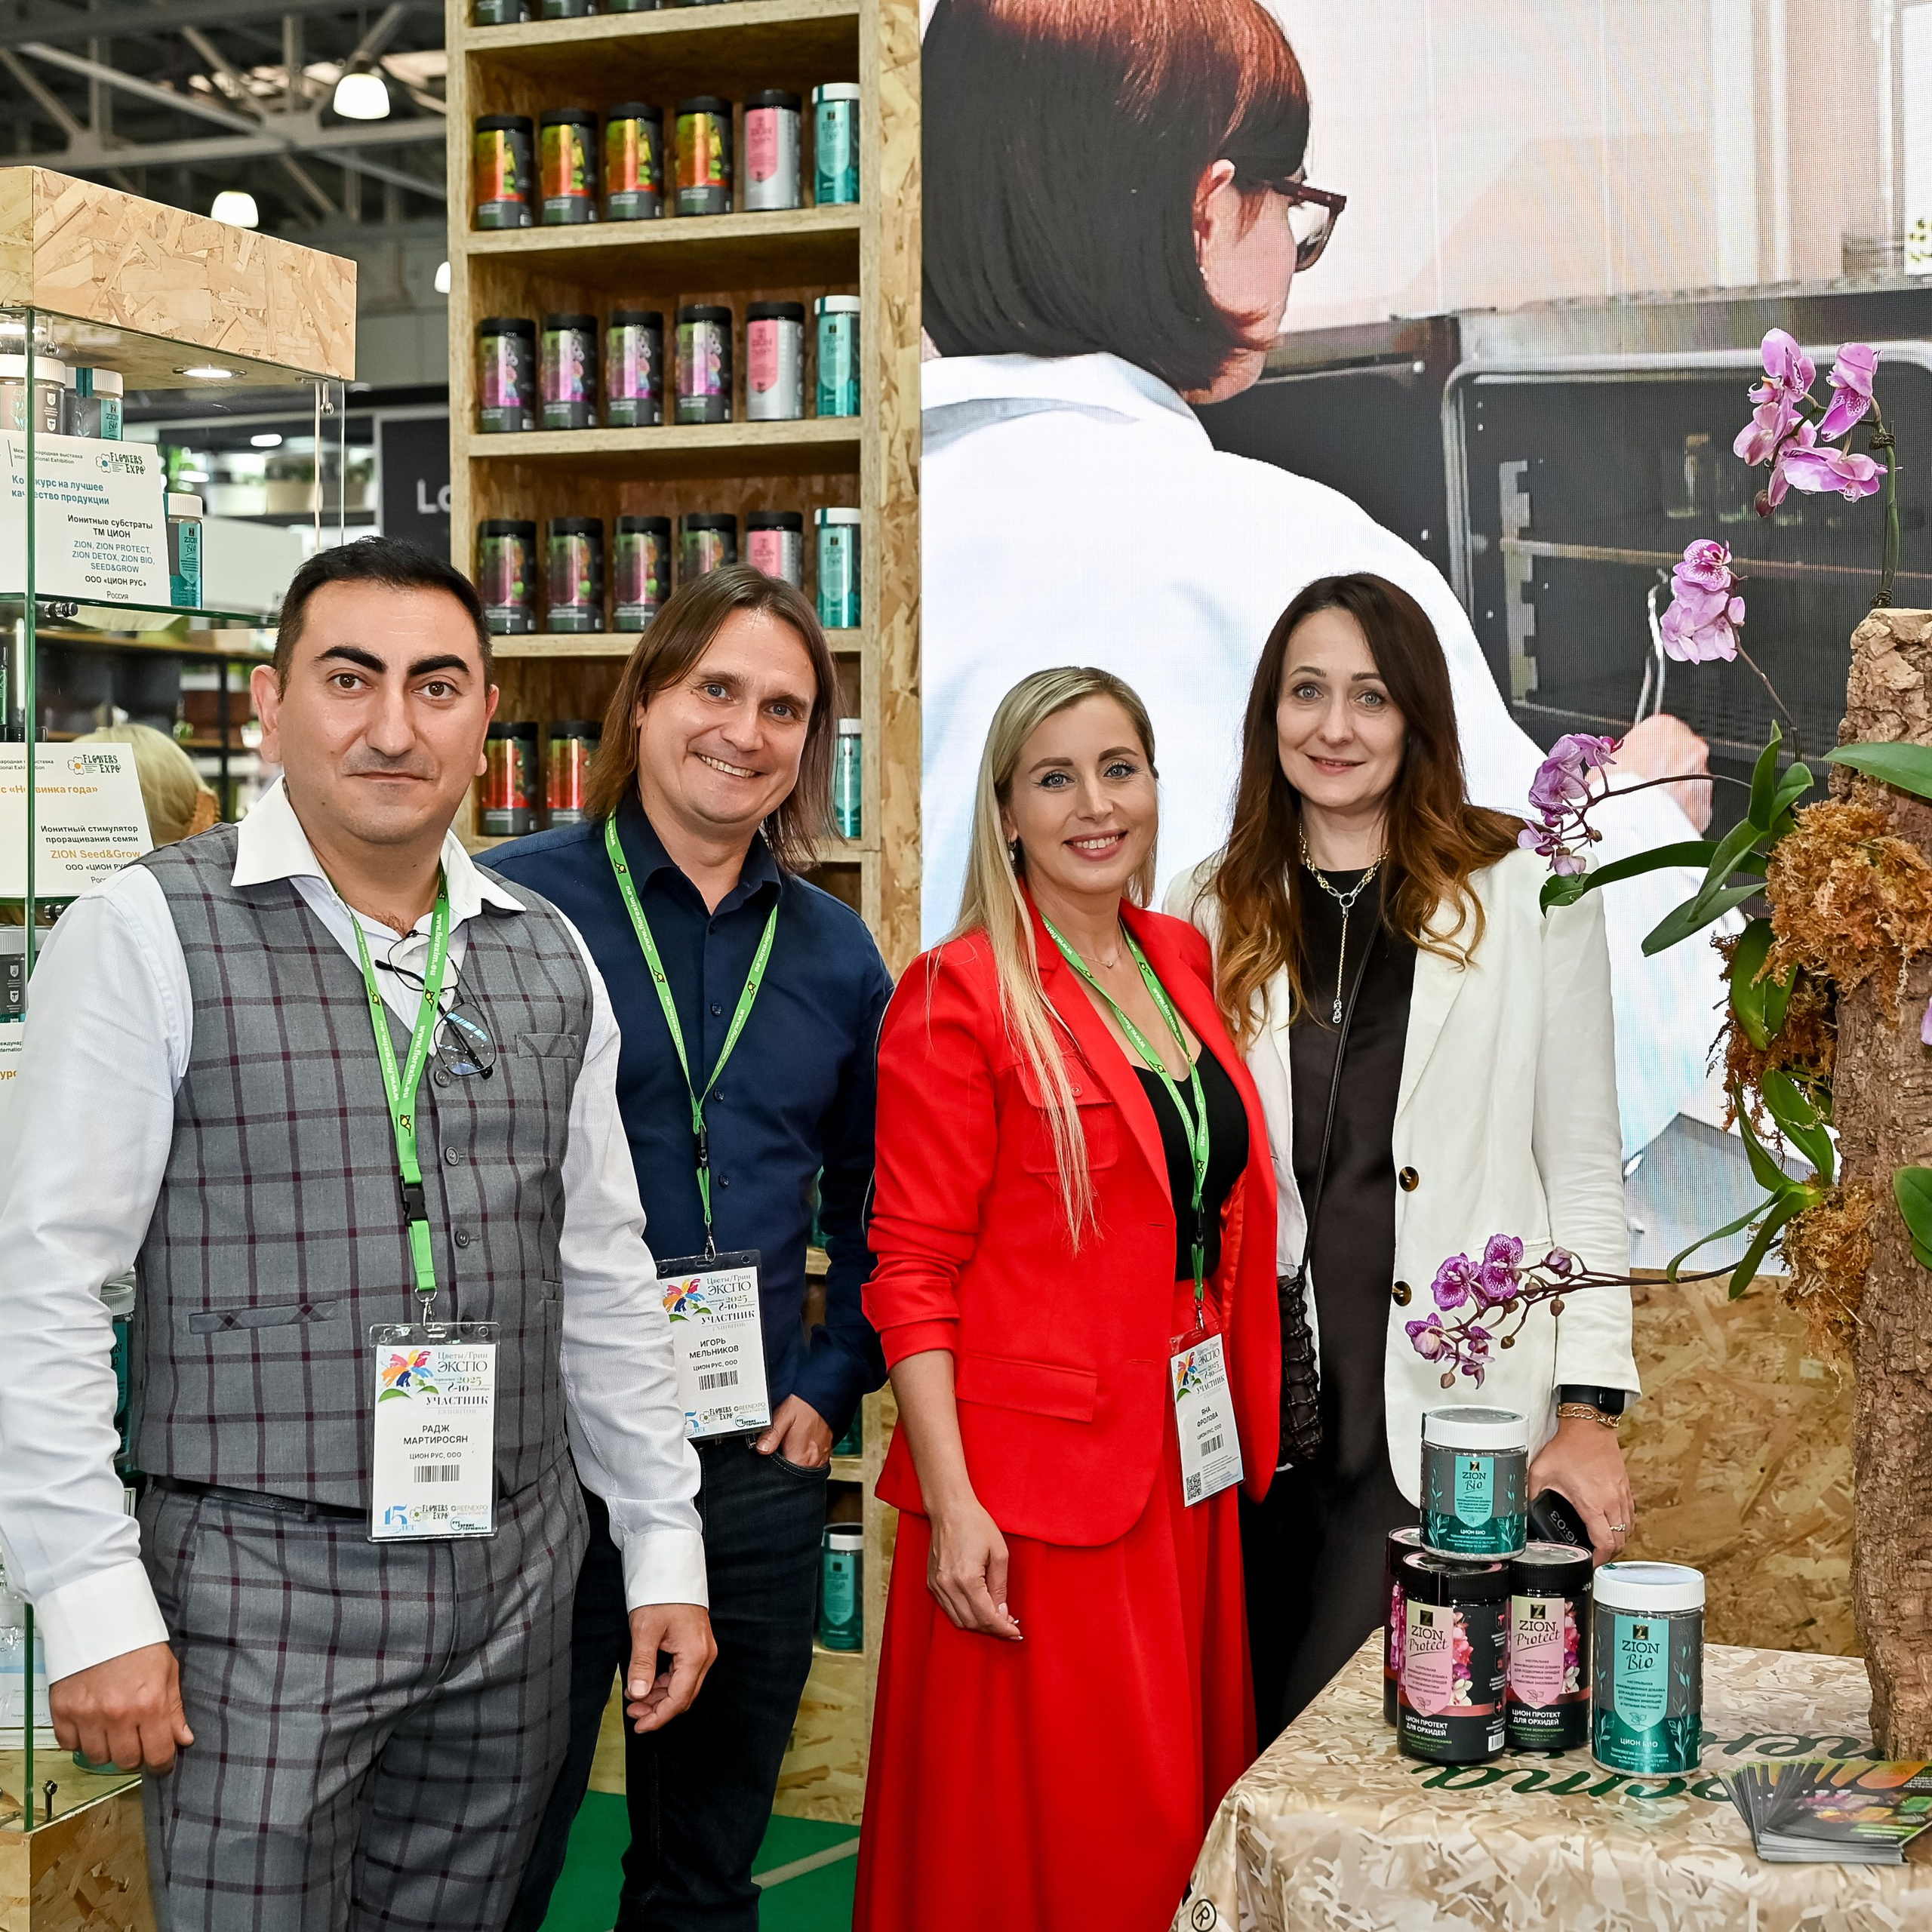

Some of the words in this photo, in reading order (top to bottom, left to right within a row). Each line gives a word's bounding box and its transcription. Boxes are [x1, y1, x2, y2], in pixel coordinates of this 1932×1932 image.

[14, 448, 59, 457] Межнародная
[12, 475, 57, 488] Кокурс
[70, 482, 103, 491] лучшее
[61, 494, 109, 506] продукции
[67, 515, 109, 525] Ионитные
[111, 518, 153, 529] субстраты
[94, 528, 105, 536] ТМ
[106, 529, 131, 540] ЦИОН
[74, 540, 94, 550] ZION,
[97, 542, 114, 550] ZION
[115, 543, 151, 554] PROTECT,
[72, 551, 91, 559] ZION
[92, 552, 119, 562] DETOX,
[122, 554, 139, 562] ZION
[140, 555, 155, 565] BIO,
[91, 562, 140, 573] SEED&GROW
[85, 575, 101, 583] ООО
[103, 577, 127, 586] «ЦИОН
[130, 578, 146, 587] РУС»
[106, 591, 128, 600] Россия
[9, 785, 66, 793] «Нвинка
[68, 786, 98, 795] года»
[88, 826, 138, 834] стимулятор
[80, 850, 141, 858] Seed&Grow
[625, 885, 653, 952] www.florexim.eu
[429, 913, 443, 976] www.florexim.eu
[378, 1020, 399, 1101] www.florexim.eu
[402, 1025, 426, 1098] www.florexim.eu
[708, 1281, 751, 1295] ЭКСПО
[725, 1295, 747, 1303] 2025
[702, 1310, 755, 1324] УЧАСТНИК
[700, 1337, 726, 1347] ИГОРЬ
[689, 1345, 739, 1359] МЕЛЬНИКОВ
[1198, 1348, 1220, 1366] ЭКСПО
[438, 1361, 488, 1372] ЭКСПО
[457, 1377, 481, 1386] 2025
[1197, 1374, 1225, 1394] УЧАСТНИК
[426, 1396, 488, 1405] УЧАСТНИК
[1201, 1406, 1211, 1415] ЯНА
[1197, 1411, 1218, 1427] ФРОЛОВА
[422, 1425, 450, 1433] РАДЖ
[404, 1435, 468, 1445] МАРТИРОСЯН
[1463, 1472, 1486, 1480] ZION
[1465, 1479, 1483, 1491] Bio
[1519, 1620, 1556, 1632] ZION
[1411, 1625, 1444, 1641] ZION
[1514, 1629, 1561, 1646] Protect
[1408, 1638, 1449, 1653] Protect
[1622, 1640, 1660, 1654] ZION
[1626, 1654, 1654, 1670] Bio
[1512, 1709, 1531, 1717] ЦИОН
[1405, 1714, 1420, 1724] ЦИОН
[1420, 1719, 1447, 1729] ПРОТЕКТ
[1527, 1718, 1559, 1726] ОРХИДЕЙ
[1406, 1722, 1416, 1730] ДЛЯ
[1417, 1726, 1446, 1736] ОРХИДЕЙ
[1620, 1737, 1641, 1746] ЦИОН
